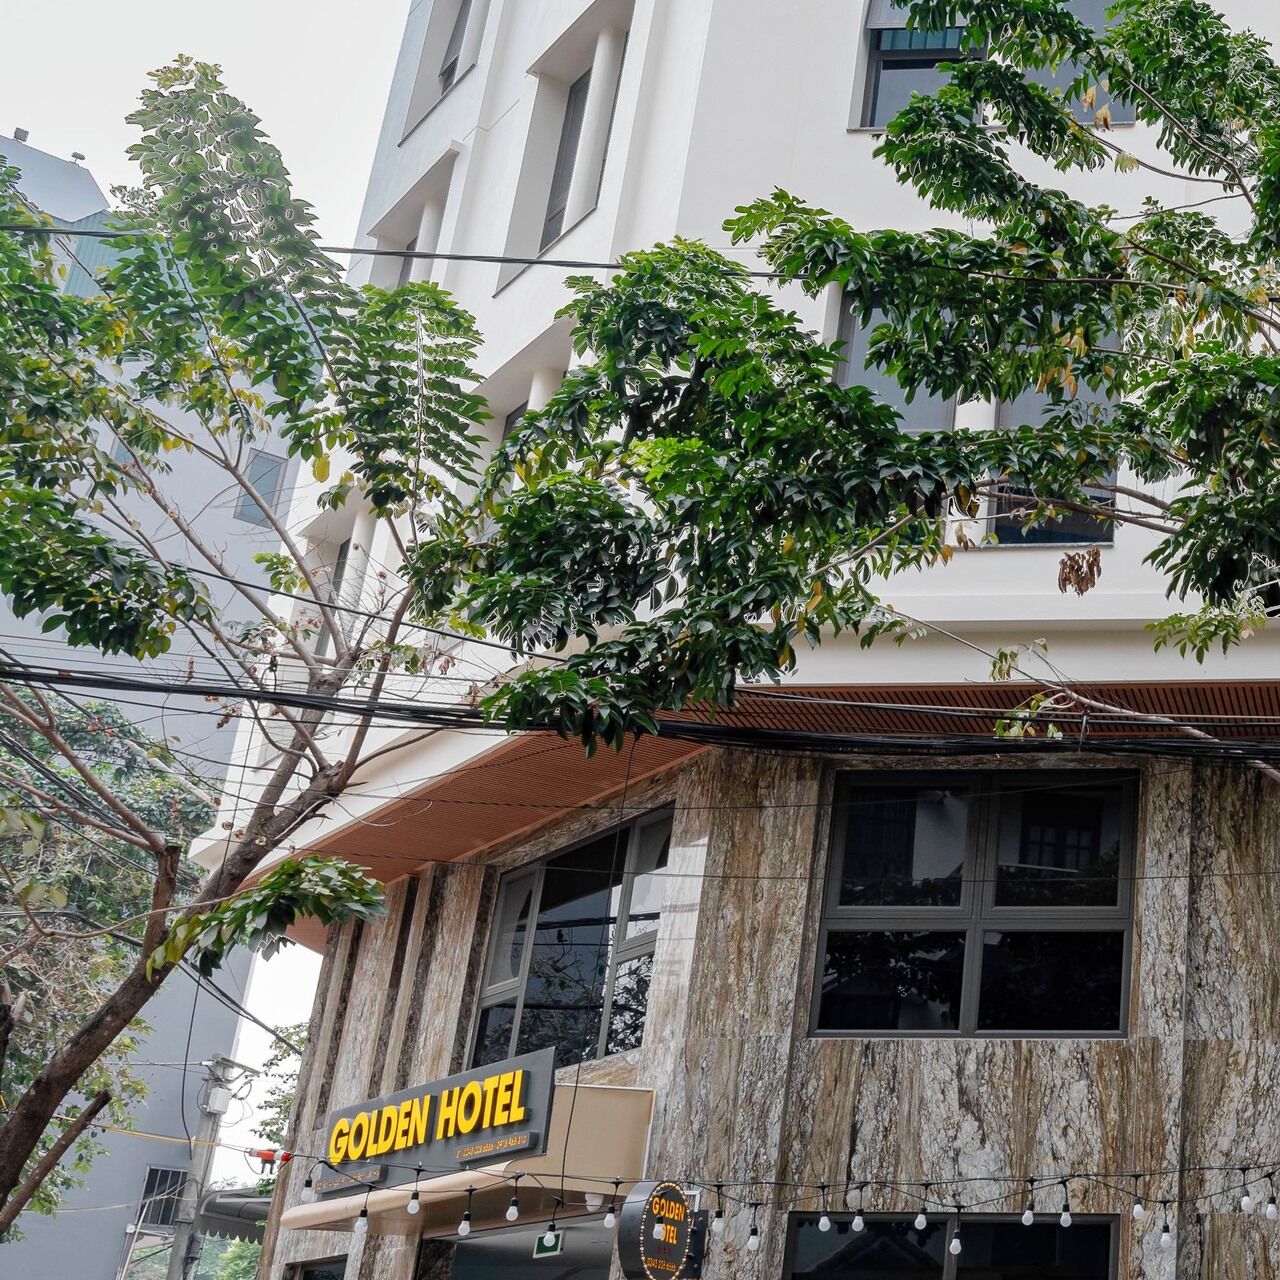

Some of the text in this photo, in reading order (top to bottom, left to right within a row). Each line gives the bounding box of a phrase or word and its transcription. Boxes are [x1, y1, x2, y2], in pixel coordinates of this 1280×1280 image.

[328, 1069, 525, 1166] GOLDEN HOTEL
[652, 1196, 685, 1222] GOLDEN
[656, 1223, 678, 1245] OTEL
